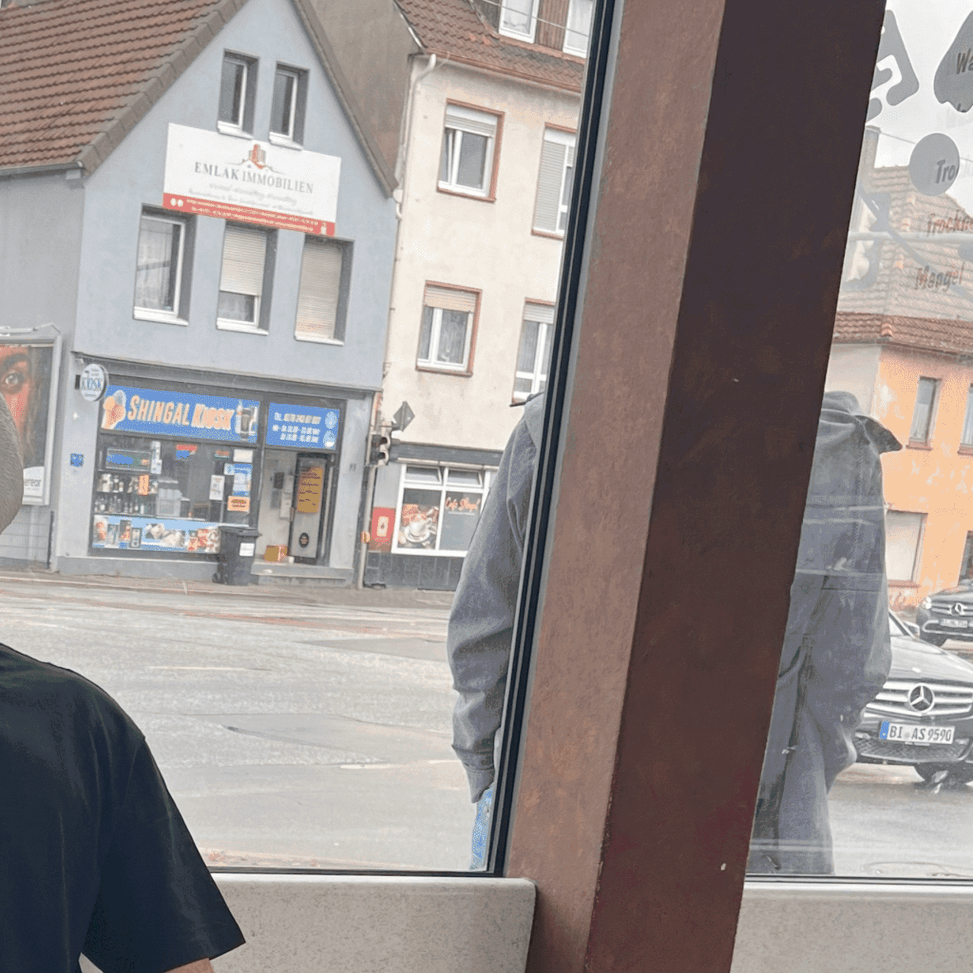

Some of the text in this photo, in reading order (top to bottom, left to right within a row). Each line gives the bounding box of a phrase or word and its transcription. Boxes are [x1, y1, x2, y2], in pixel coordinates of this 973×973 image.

[194, 161, 239, 181] EMLAK
[242, 170, 314, 194] IMMOBILIEN
[914, 262, 965, 292] Mangel
[889, 726, 952, 742] BI AS 9590
